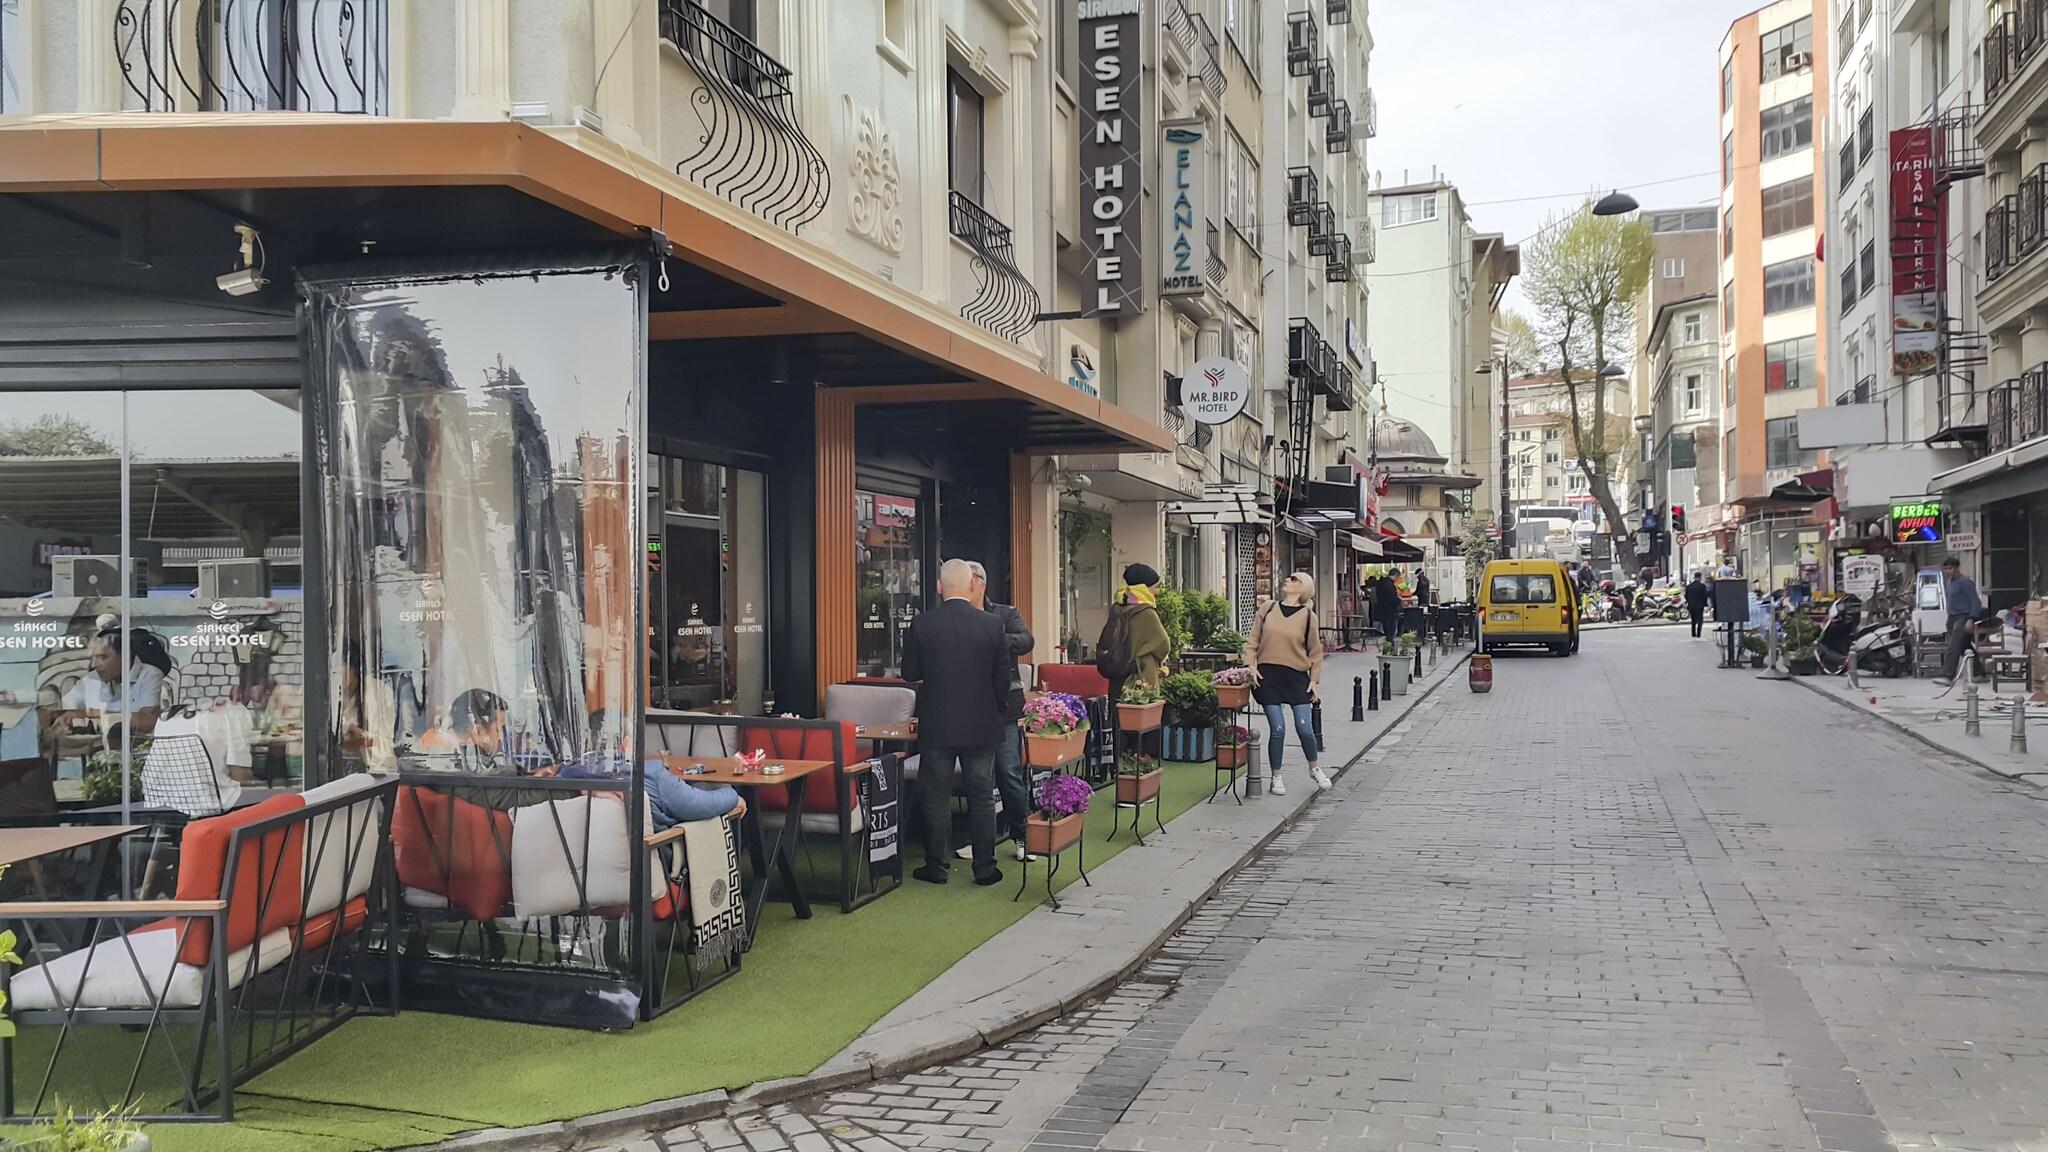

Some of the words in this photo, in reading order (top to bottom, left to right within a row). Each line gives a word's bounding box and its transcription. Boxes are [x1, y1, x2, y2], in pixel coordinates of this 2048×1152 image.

[1094, 23, 1122, 144] ESEN
[1174, 149, 1193, 272] ELANAZ
[1092, 164, 1124, 311] HOTEL
[1163, 275, 1203, 289] HOTEL
[1189, 392, 1211, 402] MR.
[1212, 391, 1239, 402] BIRD
[1198, 403, 1228, 413] HOTEL
[1463, 488, 1472, 518] HOTE
[1893, 503, 1940, 518] BERBER
[1899, 517, 1936, 528] AYHAN
[399, 610, 424, 622] ESEN
[14, 620, 57, 632] SİRKECİ
[196, 621, 241, 633] SİRKECİ
[34, 636, 84, 649] HOTEL
[170, 634, 210, 647] ESEN
[214, 634, 267, 646] HOTEL
